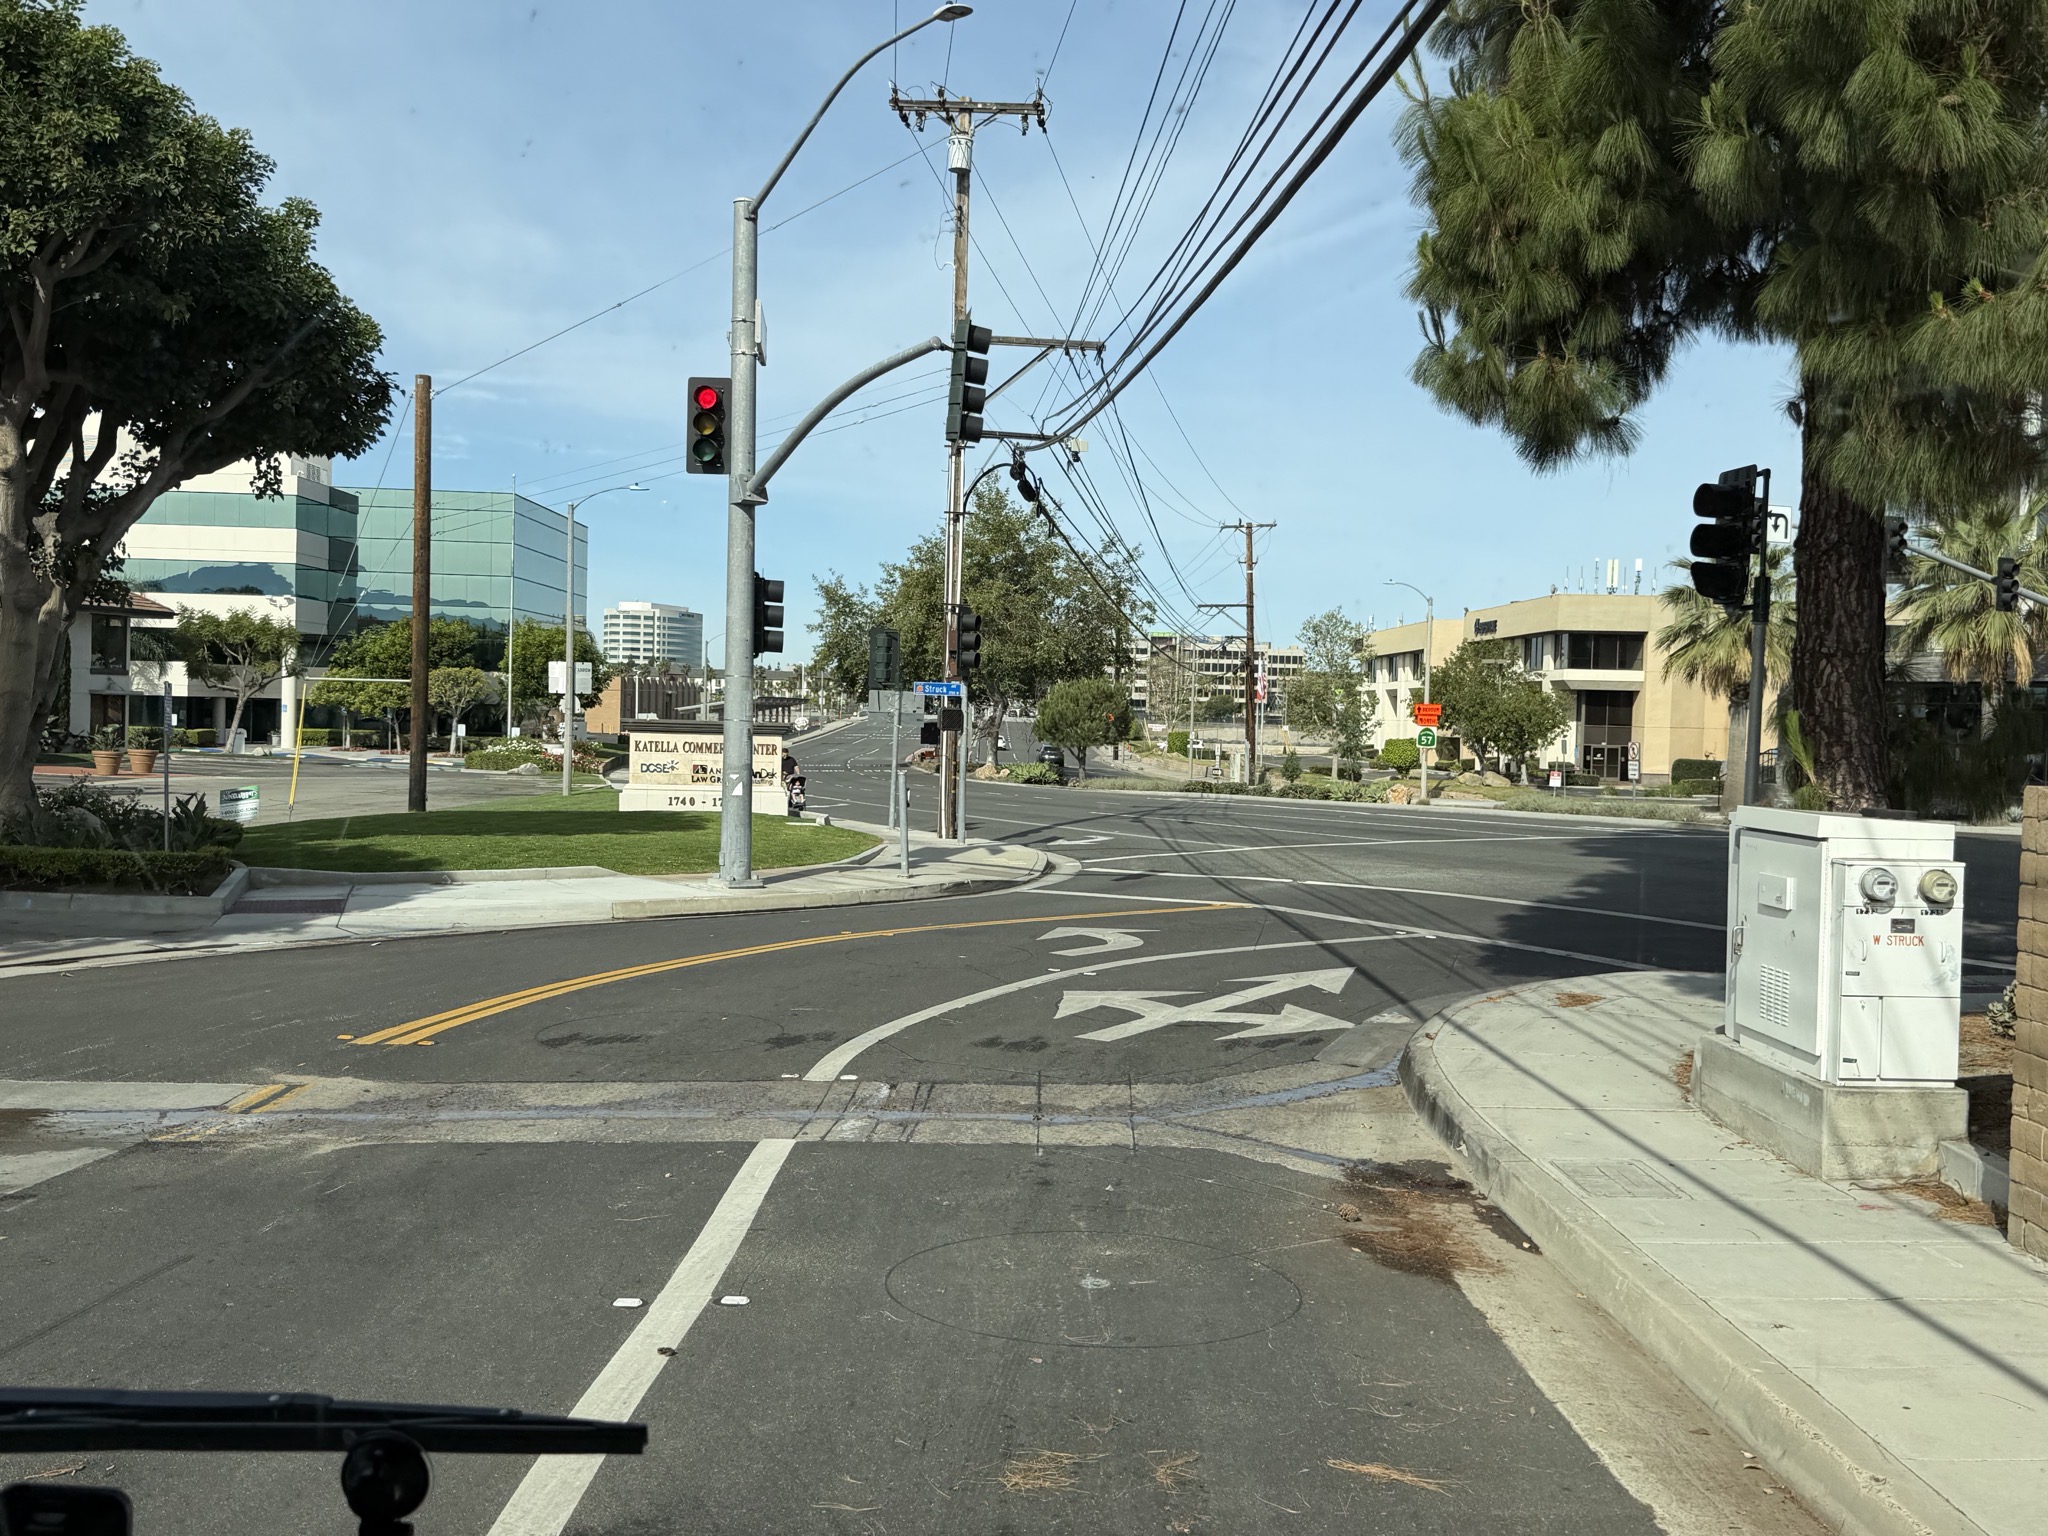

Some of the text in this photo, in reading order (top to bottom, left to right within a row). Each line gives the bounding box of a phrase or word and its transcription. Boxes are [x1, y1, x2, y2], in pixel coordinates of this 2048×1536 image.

[925, 685, 947, 693] Struck
[1421, 736, 1433, 745] 57
[634, 740, 679, 753] KATELLA
[691, 775, 708, 783] LAW
[668, 796, 696, 807] 1740
[1872, 934, 1925, 947] W STRUCK
